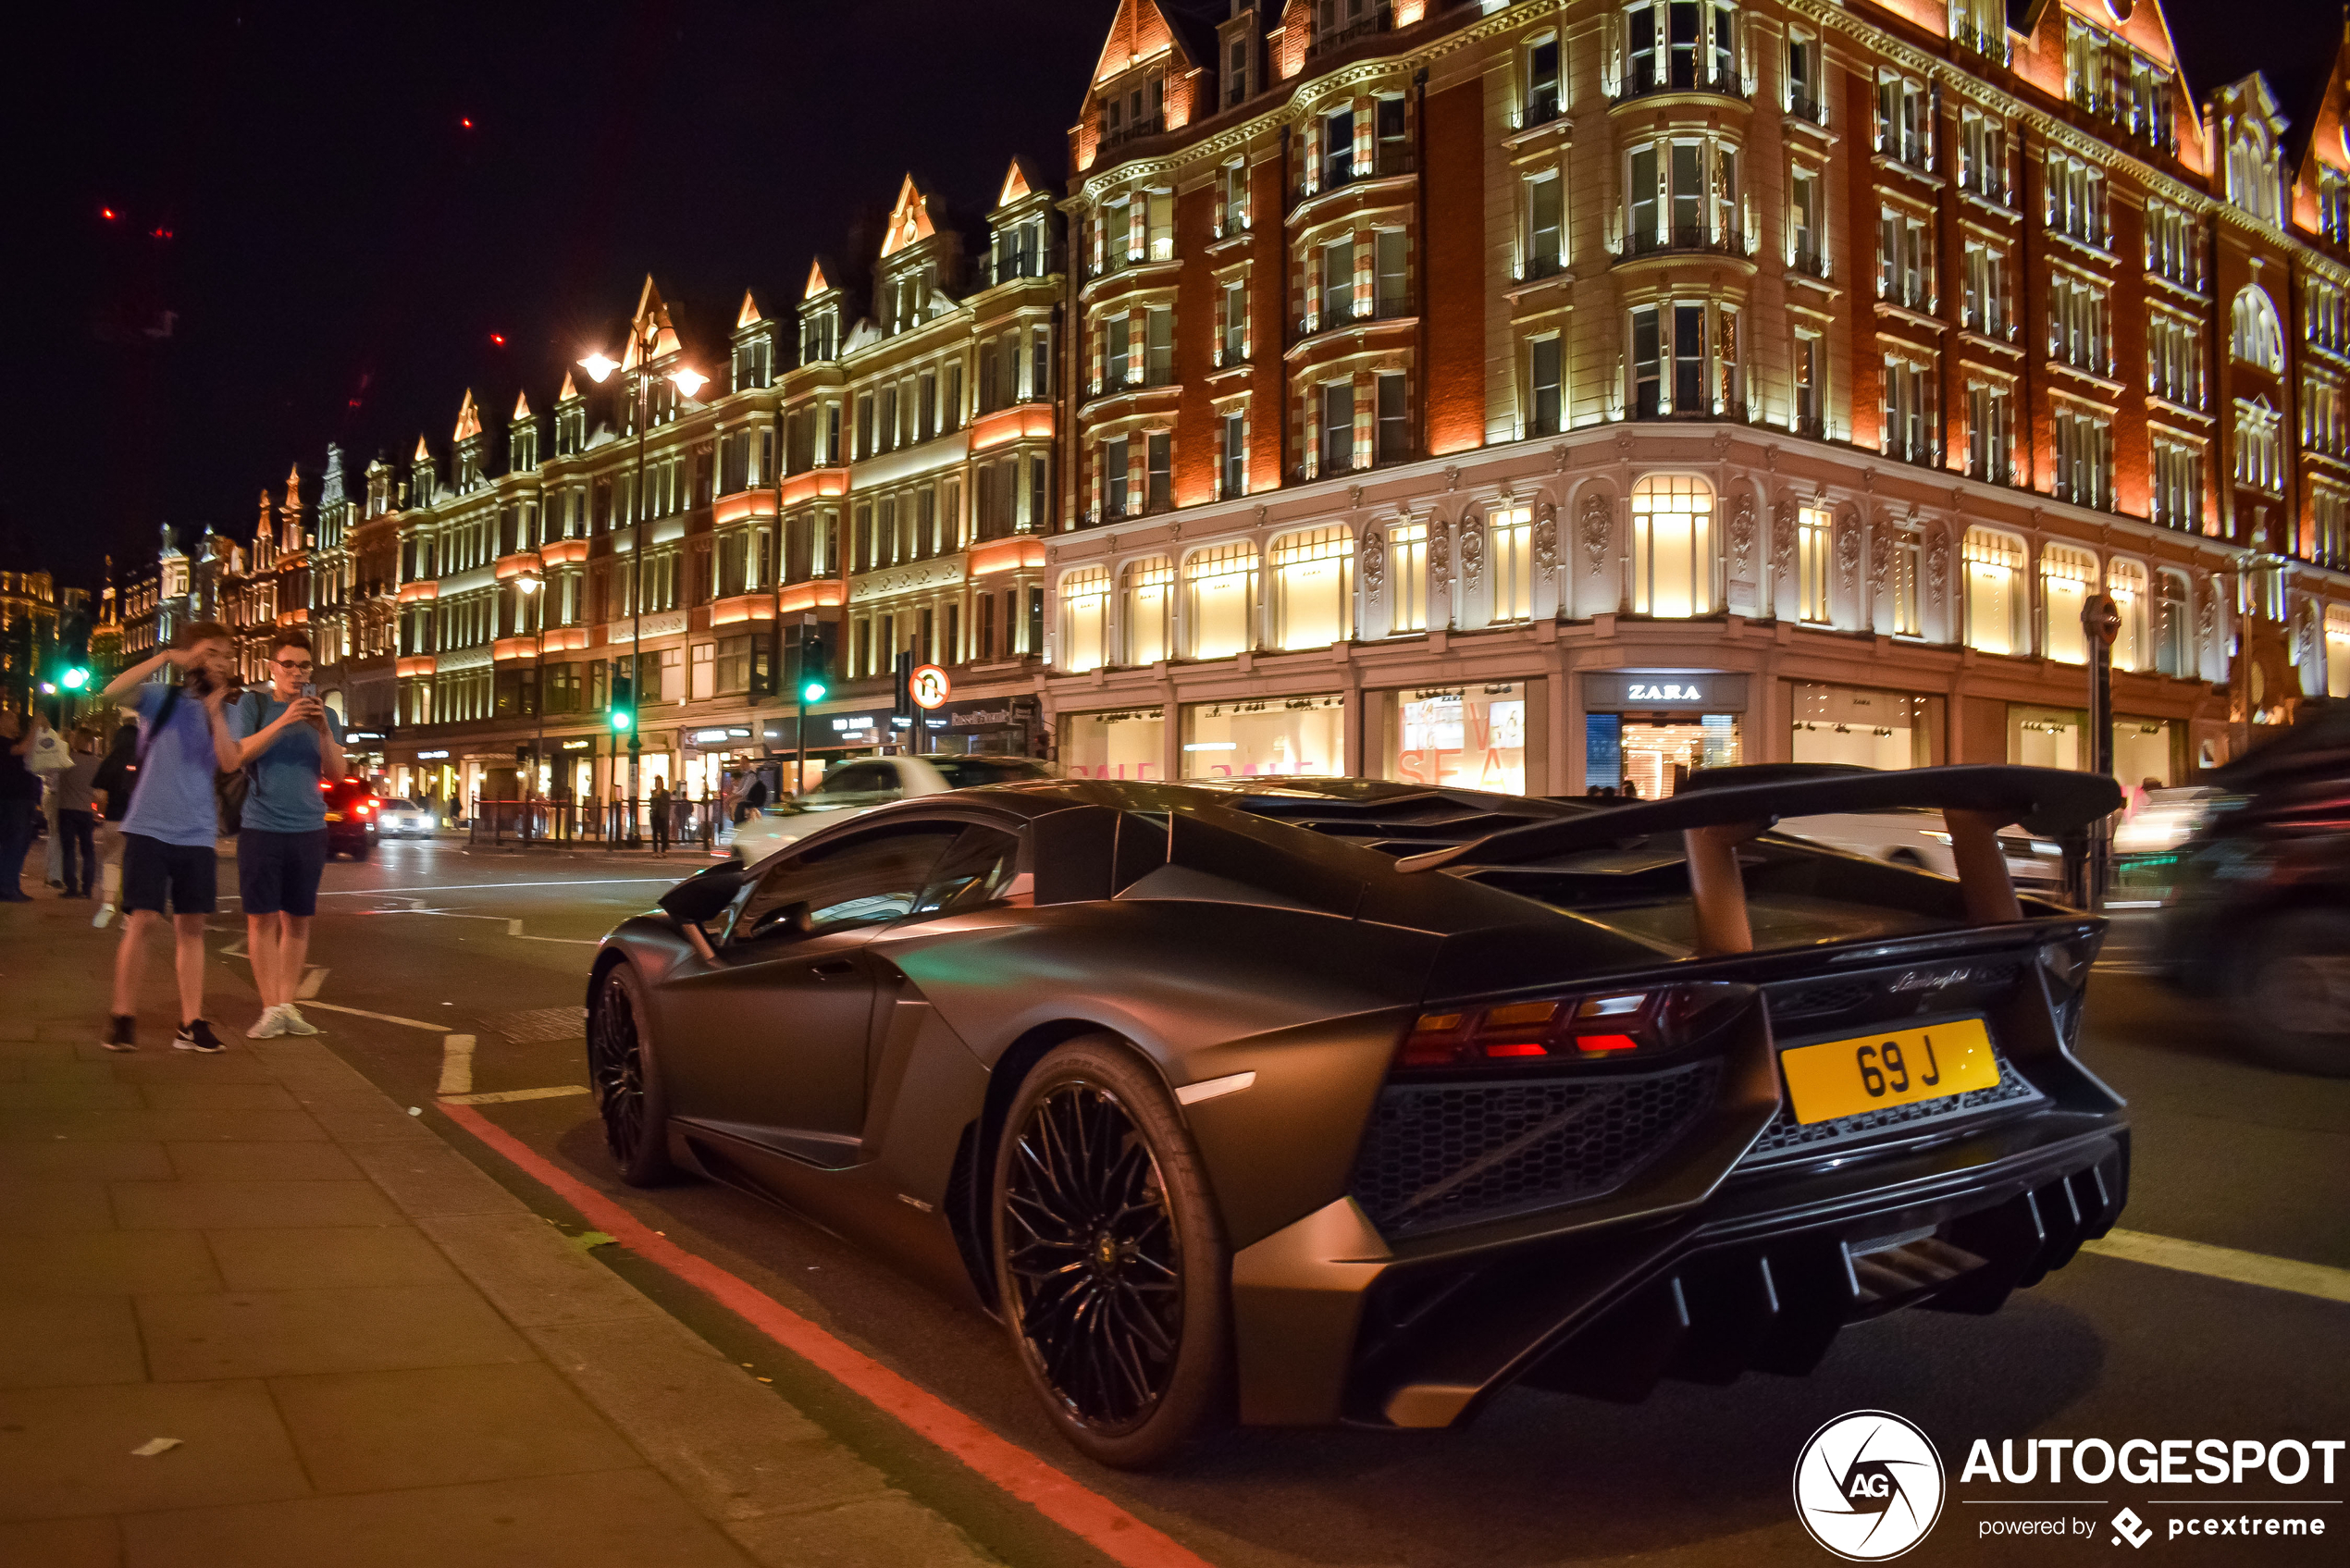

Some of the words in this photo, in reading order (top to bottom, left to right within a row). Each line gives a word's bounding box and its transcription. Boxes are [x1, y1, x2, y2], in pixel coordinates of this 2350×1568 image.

[1629, 685, 1702, 699] ZARA
[1857, 1042, 1909, 1097] 69
[1922, 1035, 1939, 1086] J
